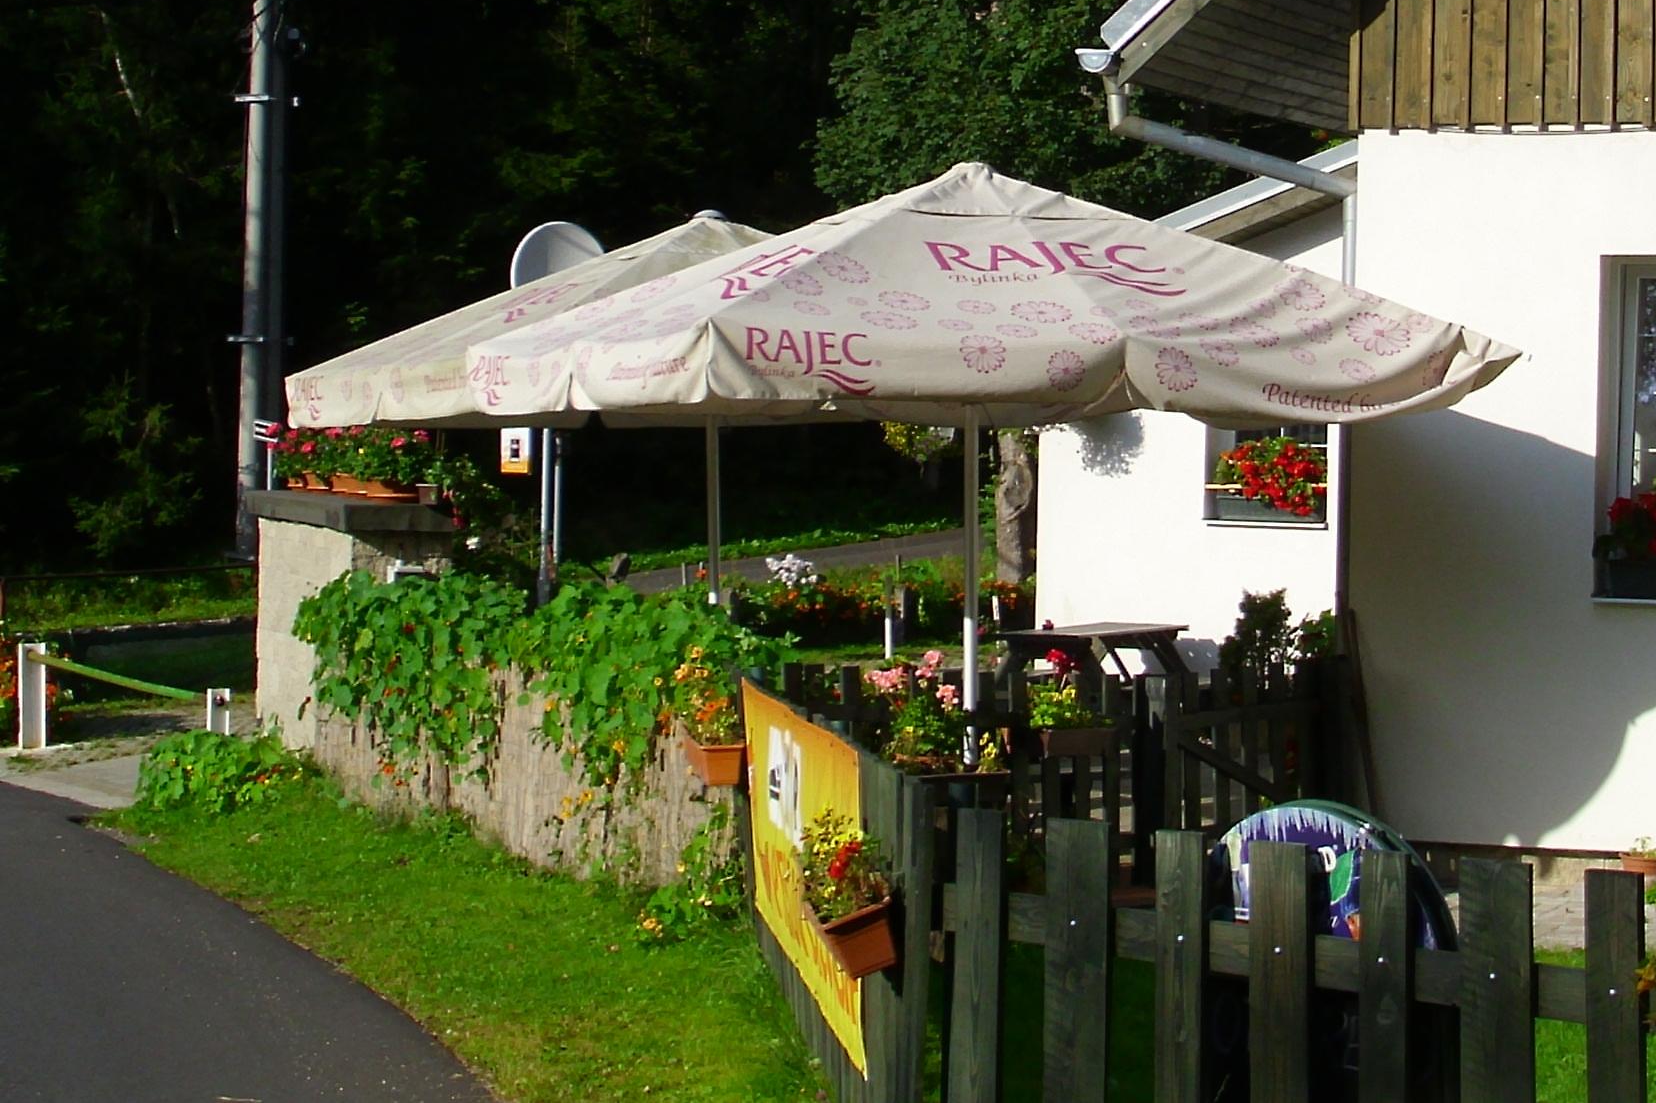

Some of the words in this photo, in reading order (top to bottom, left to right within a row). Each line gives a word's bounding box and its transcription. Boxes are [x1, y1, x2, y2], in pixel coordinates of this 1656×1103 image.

[924, 241, 1167, 275] RAJEC
[949, 272, 1040, 287] Bylinka
[745, 327, 872, 375] RAJEC
[1262, 383, 1358, 413] Patented
